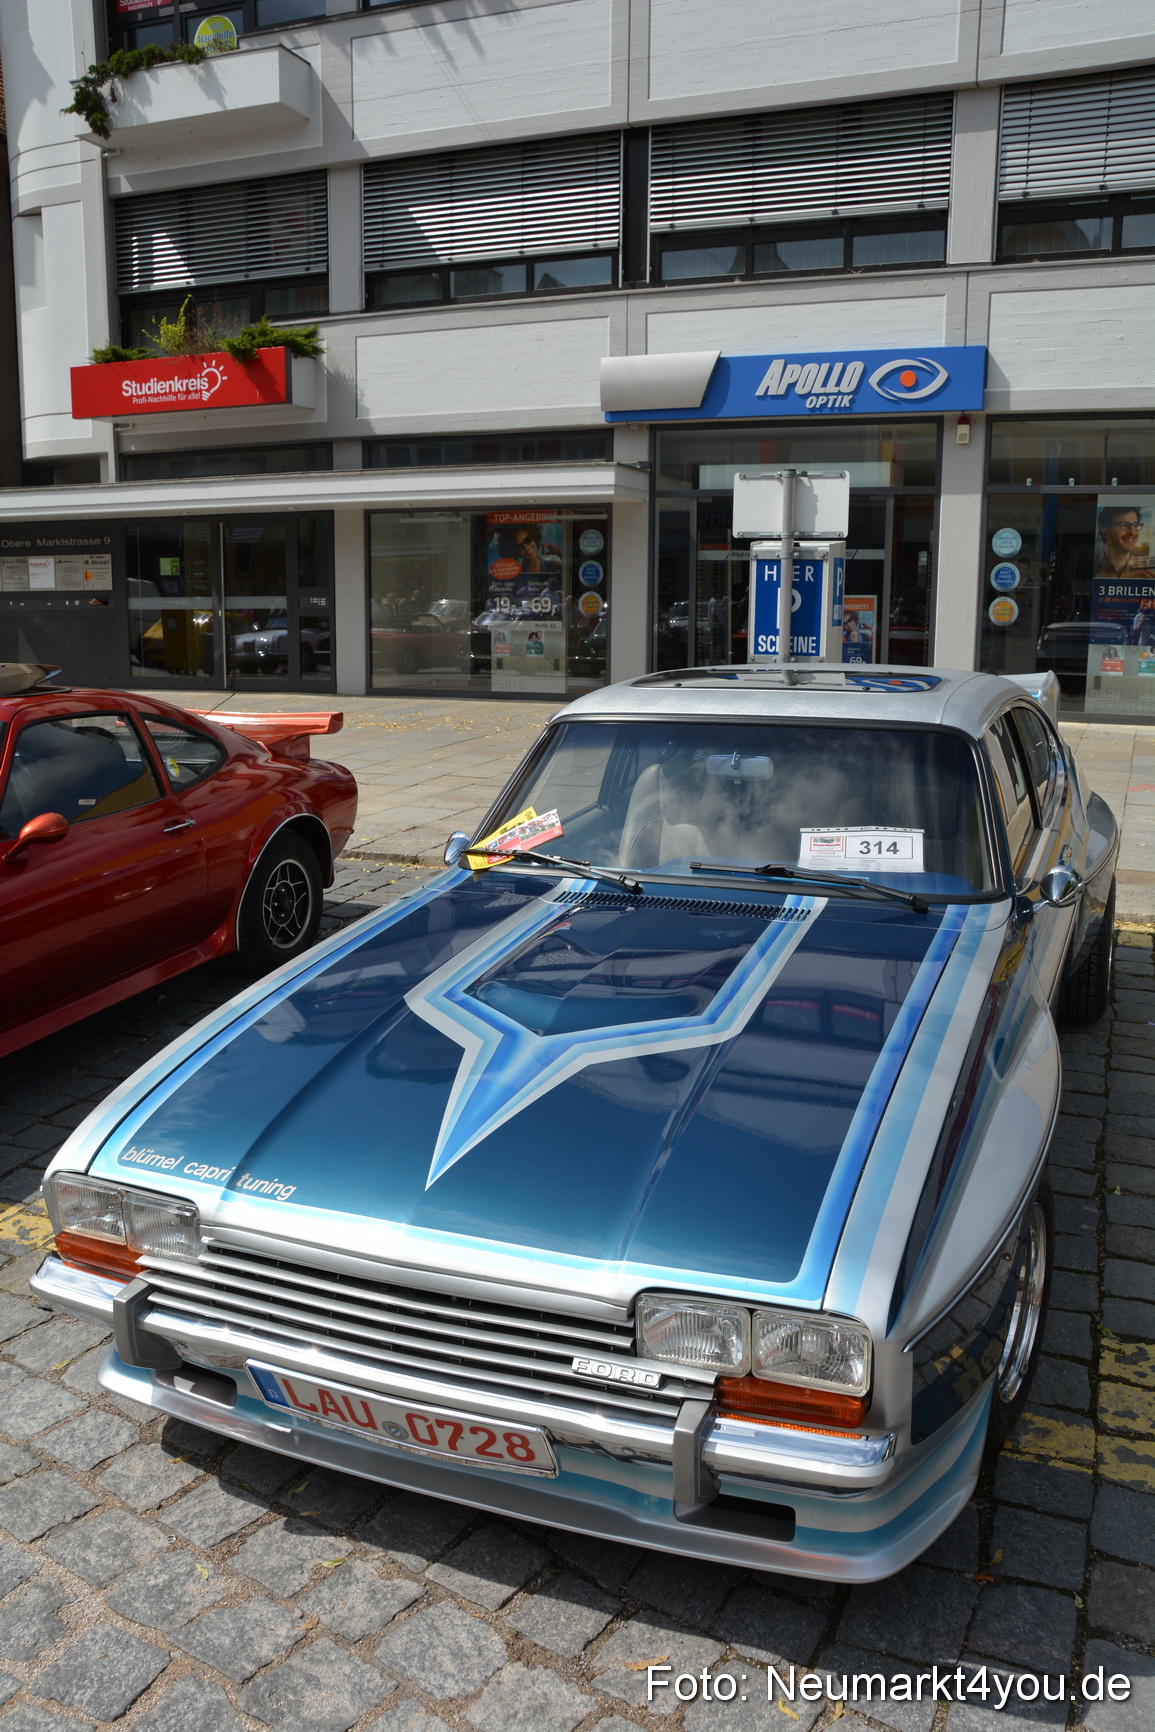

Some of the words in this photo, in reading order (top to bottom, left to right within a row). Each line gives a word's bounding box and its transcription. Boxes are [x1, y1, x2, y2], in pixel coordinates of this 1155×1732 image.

[198, 30, 234, 43] Nachhilfe
[121, 373, 209, 397] Studienkreis
[755, 359, 864, 396] APOLLO
[132, 395, 177, 405] Profi-Nachhilfe
[177, 393, 186, 401] für
[187, 392, 201, 400] alle!
[805, 394, 854, 409] OPTIK
[1, 539, 31, 548] Obere
[37, 537, 101, 547] Marktstrasse
[104, 536, 111, 545] 9
[764, 565, 814, 582] HER
[1098, 586, 1105, 596] 3
[1108, 586, 1155, 596] BRILLEN
[859, 841, 899, 854] 314
[121, 1146, 184, 1170] blümel
[183, 1161, 236, 1182] capri
[236, 1173, 298, 1201] tuning
[576, 1358, 659, 1387] FORD
[268, 1388, 278, 1398] D
[281, 1378, 378, 1431] LAU
